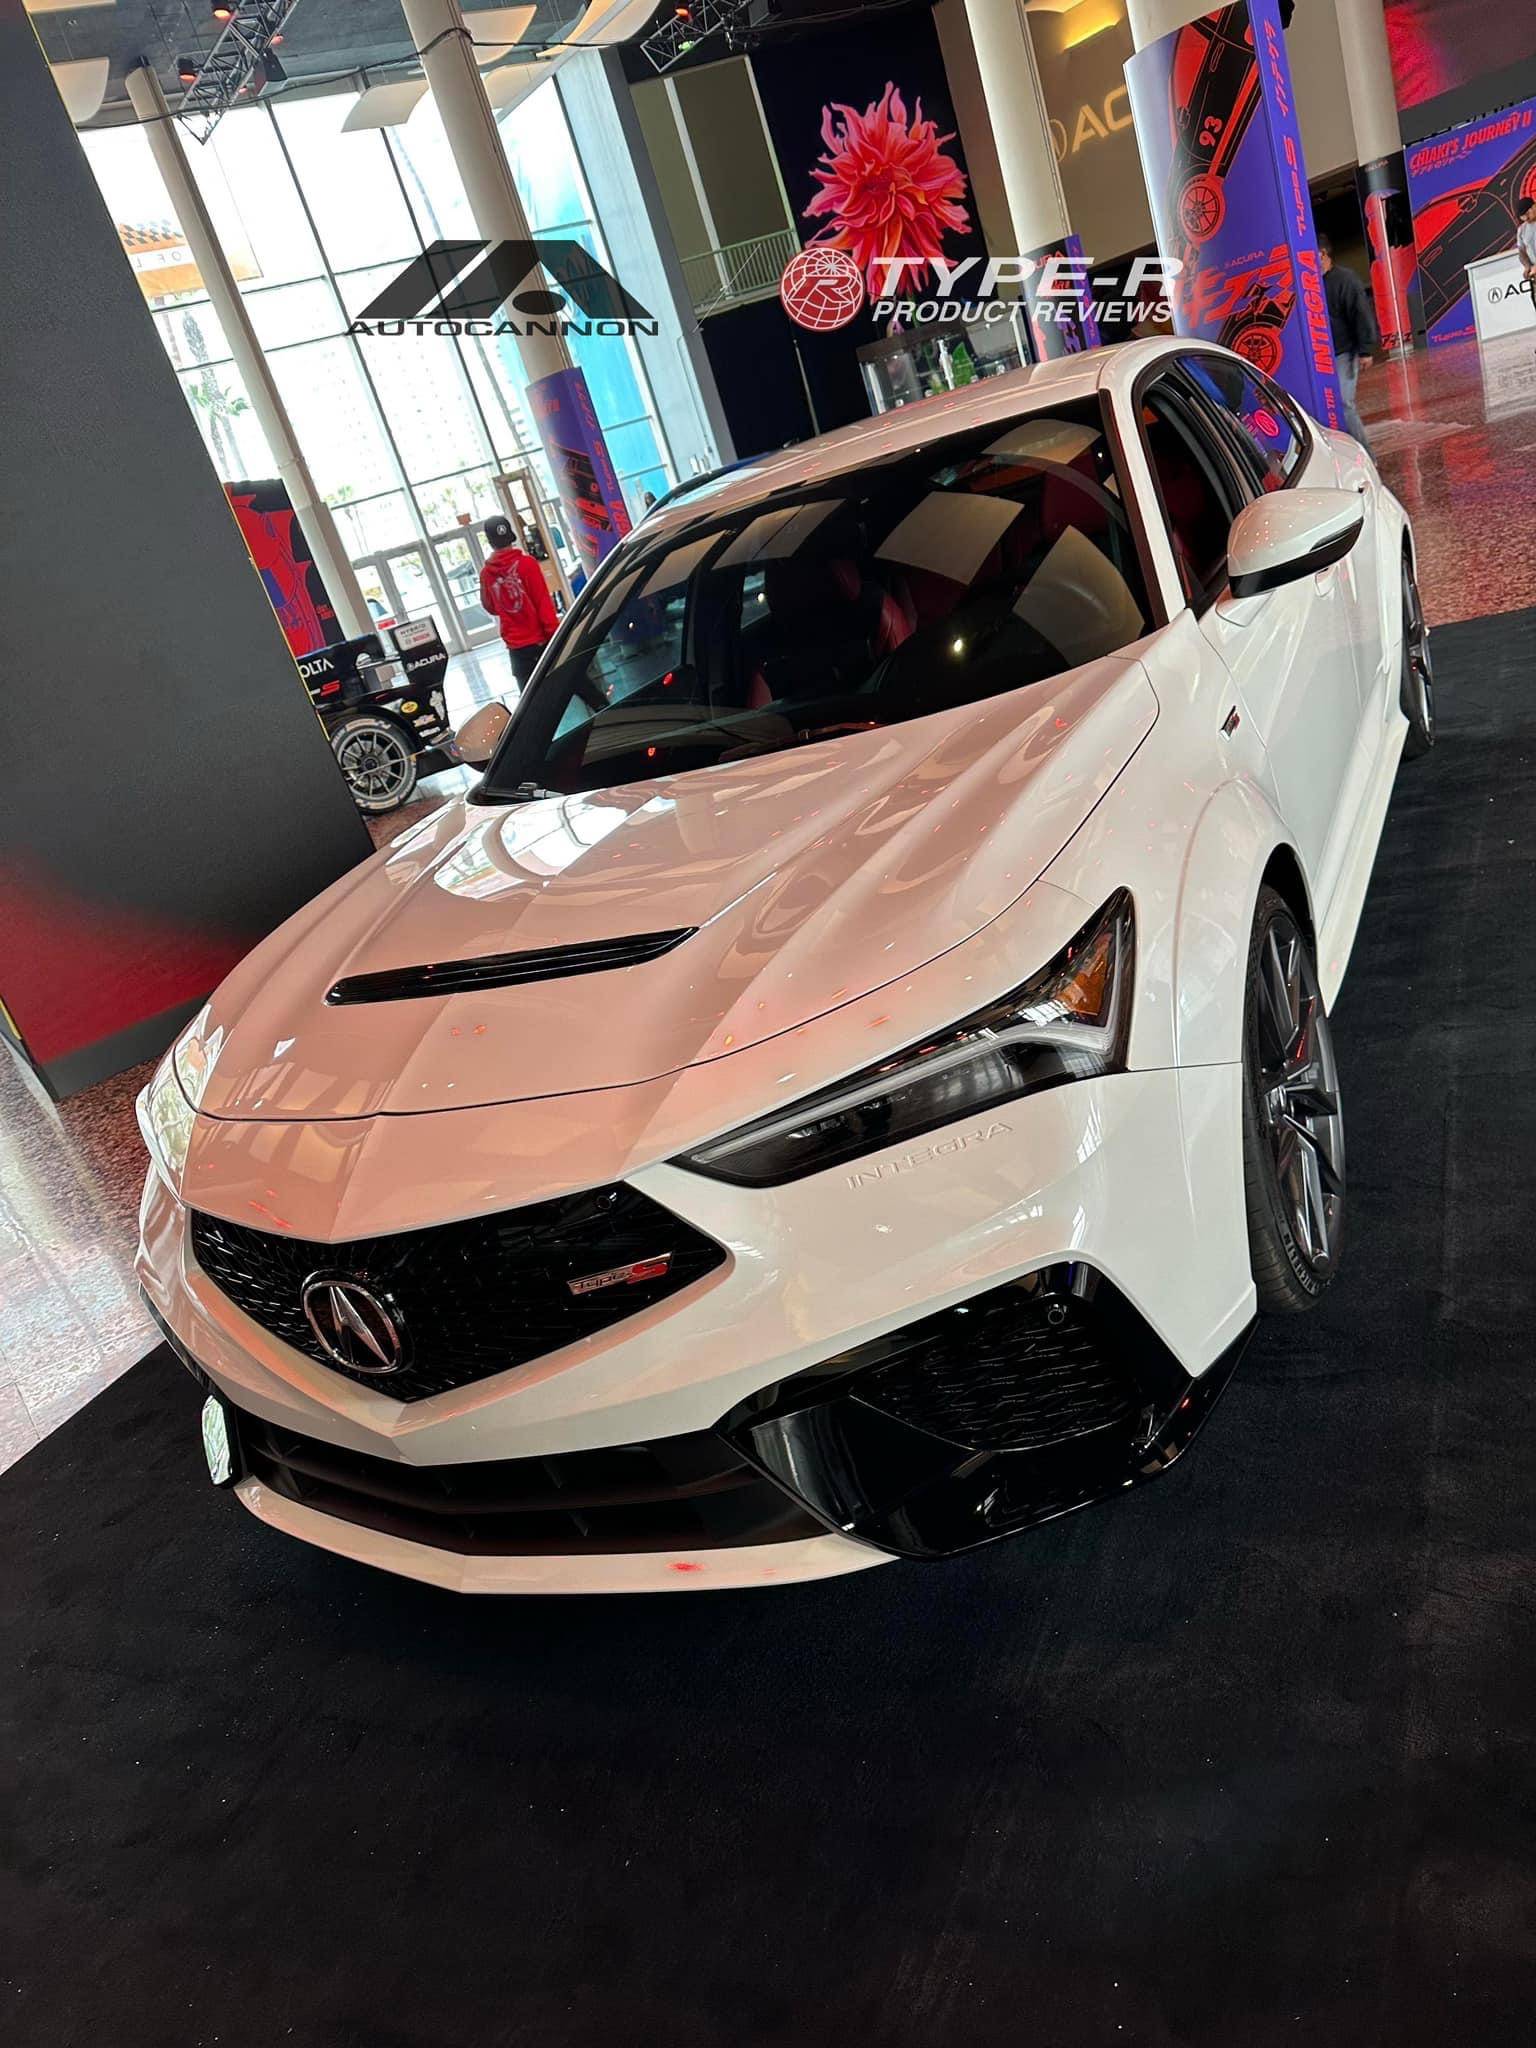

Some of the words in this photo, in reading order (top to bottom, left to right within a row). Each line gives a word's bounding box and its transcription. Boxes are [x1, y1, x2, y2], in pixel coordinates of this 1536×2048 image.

[1199, 116, 1222, 147] 93
[1462, 111, 1521, 150] JOURNEY
[1297, 250, 1335, 375] INTEGRA
[414, 653, 446, 670] ACURA
[845, 1122, 1013, 1190] INTEGRA
